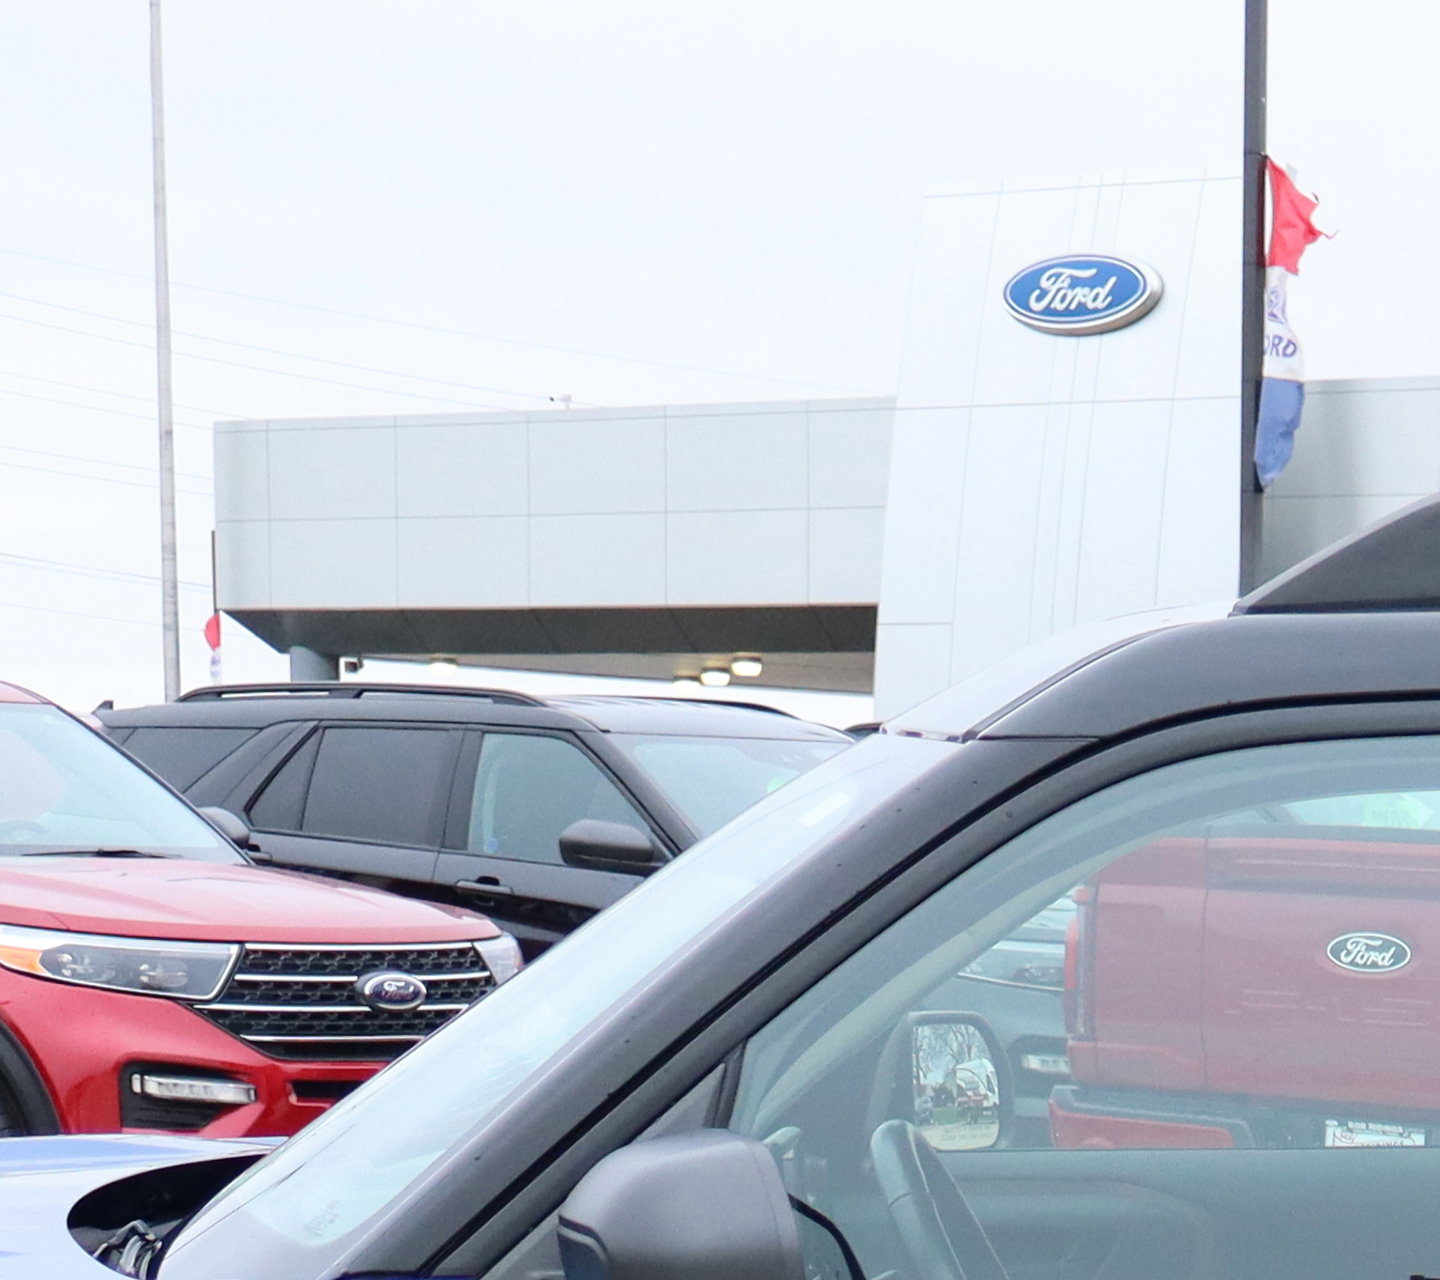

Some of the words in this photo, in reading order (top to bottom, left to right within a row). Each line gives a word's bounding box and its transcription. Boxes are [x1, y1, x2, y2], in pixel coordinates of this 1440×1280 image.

[1029, 267, 1117, 312] Ford
[1340, 938, 1396, 967] Ford
[382, 980, 414, 1001] Ford
